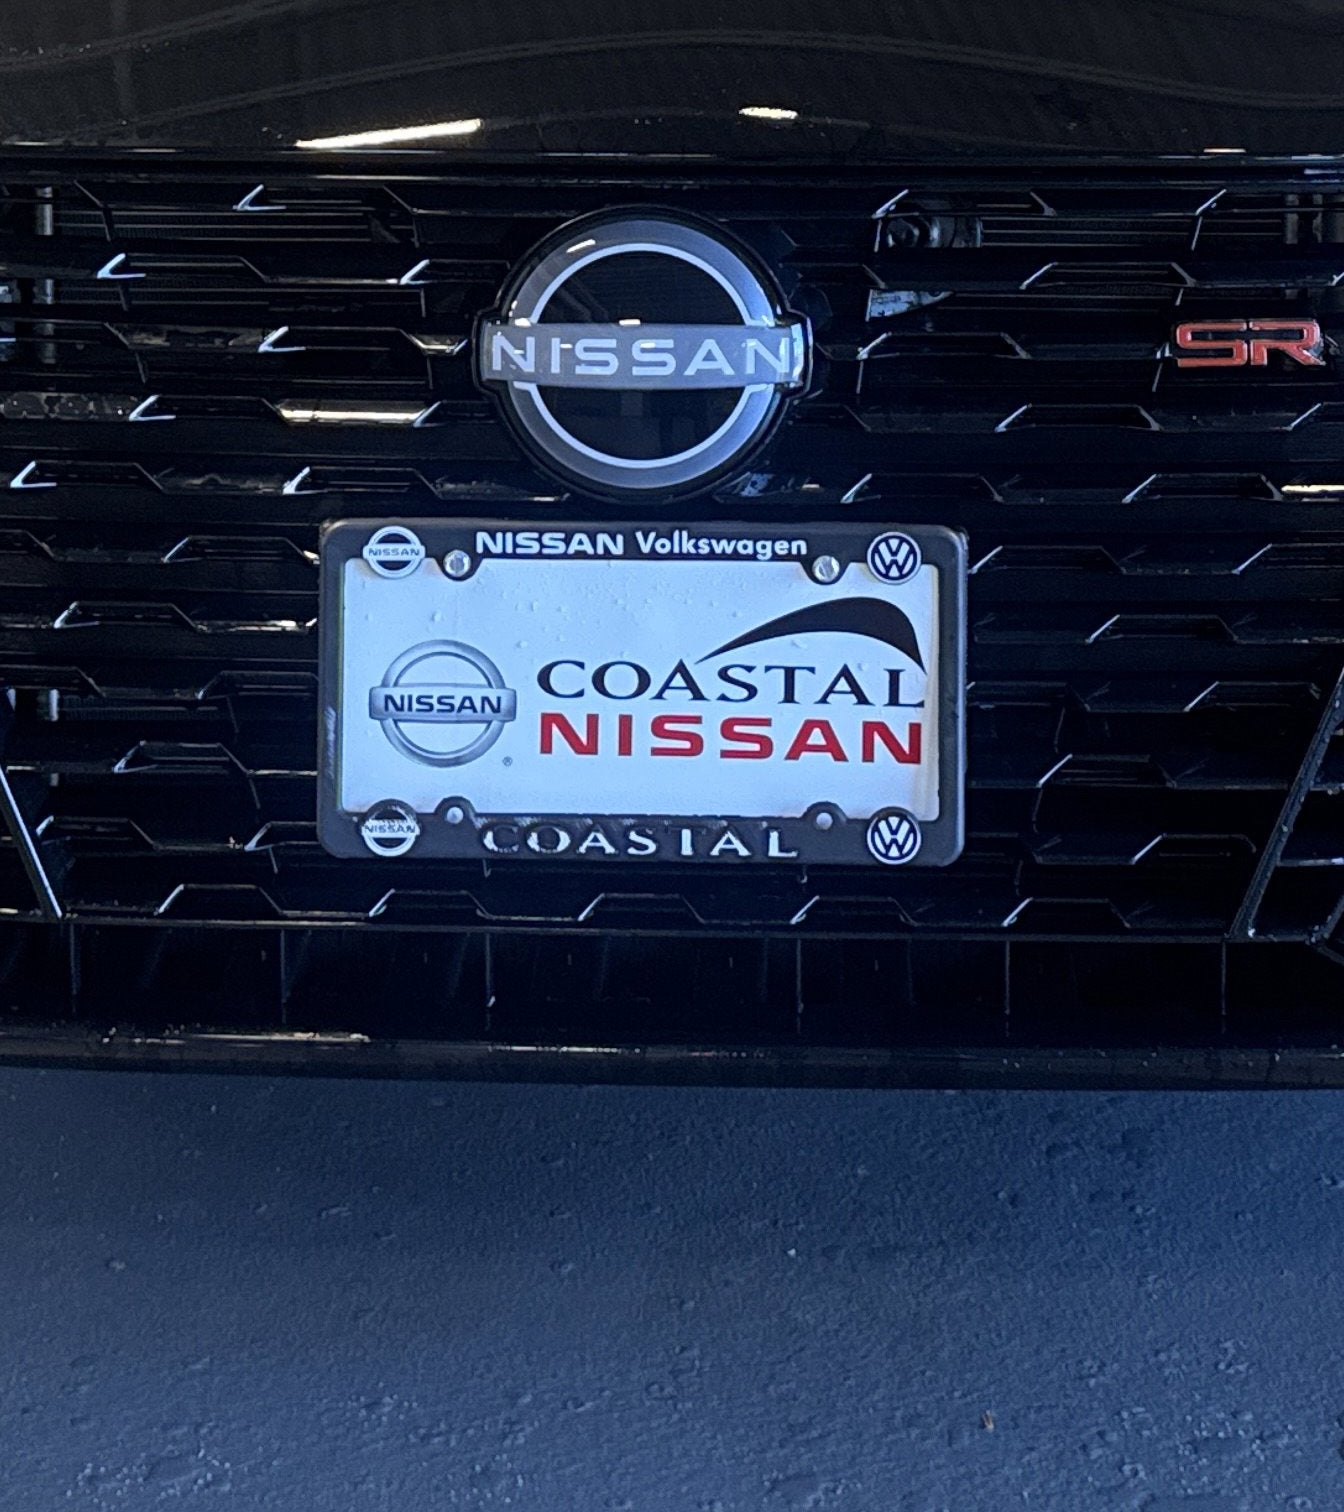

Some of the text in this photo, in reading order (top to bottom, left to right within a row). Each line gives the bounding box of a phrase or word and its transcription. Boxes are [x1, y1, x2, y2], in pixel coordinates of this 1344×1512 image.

[491, 334, 791, 377] NISSAN
[1175, 319, 1327, 368] SR
[368, 547, 420, 557] NISSAN
[475, 529, 808, 561] NISSAN Volkswagen
[537, 657, 926, 709] COASTAL
[383, 693, 503, 715] NISSAN
[539, 711, 922, 765] NISSAN
[364, 824, 416, 834] NISSAN
[482, 824, 800, 858] COASTAL
